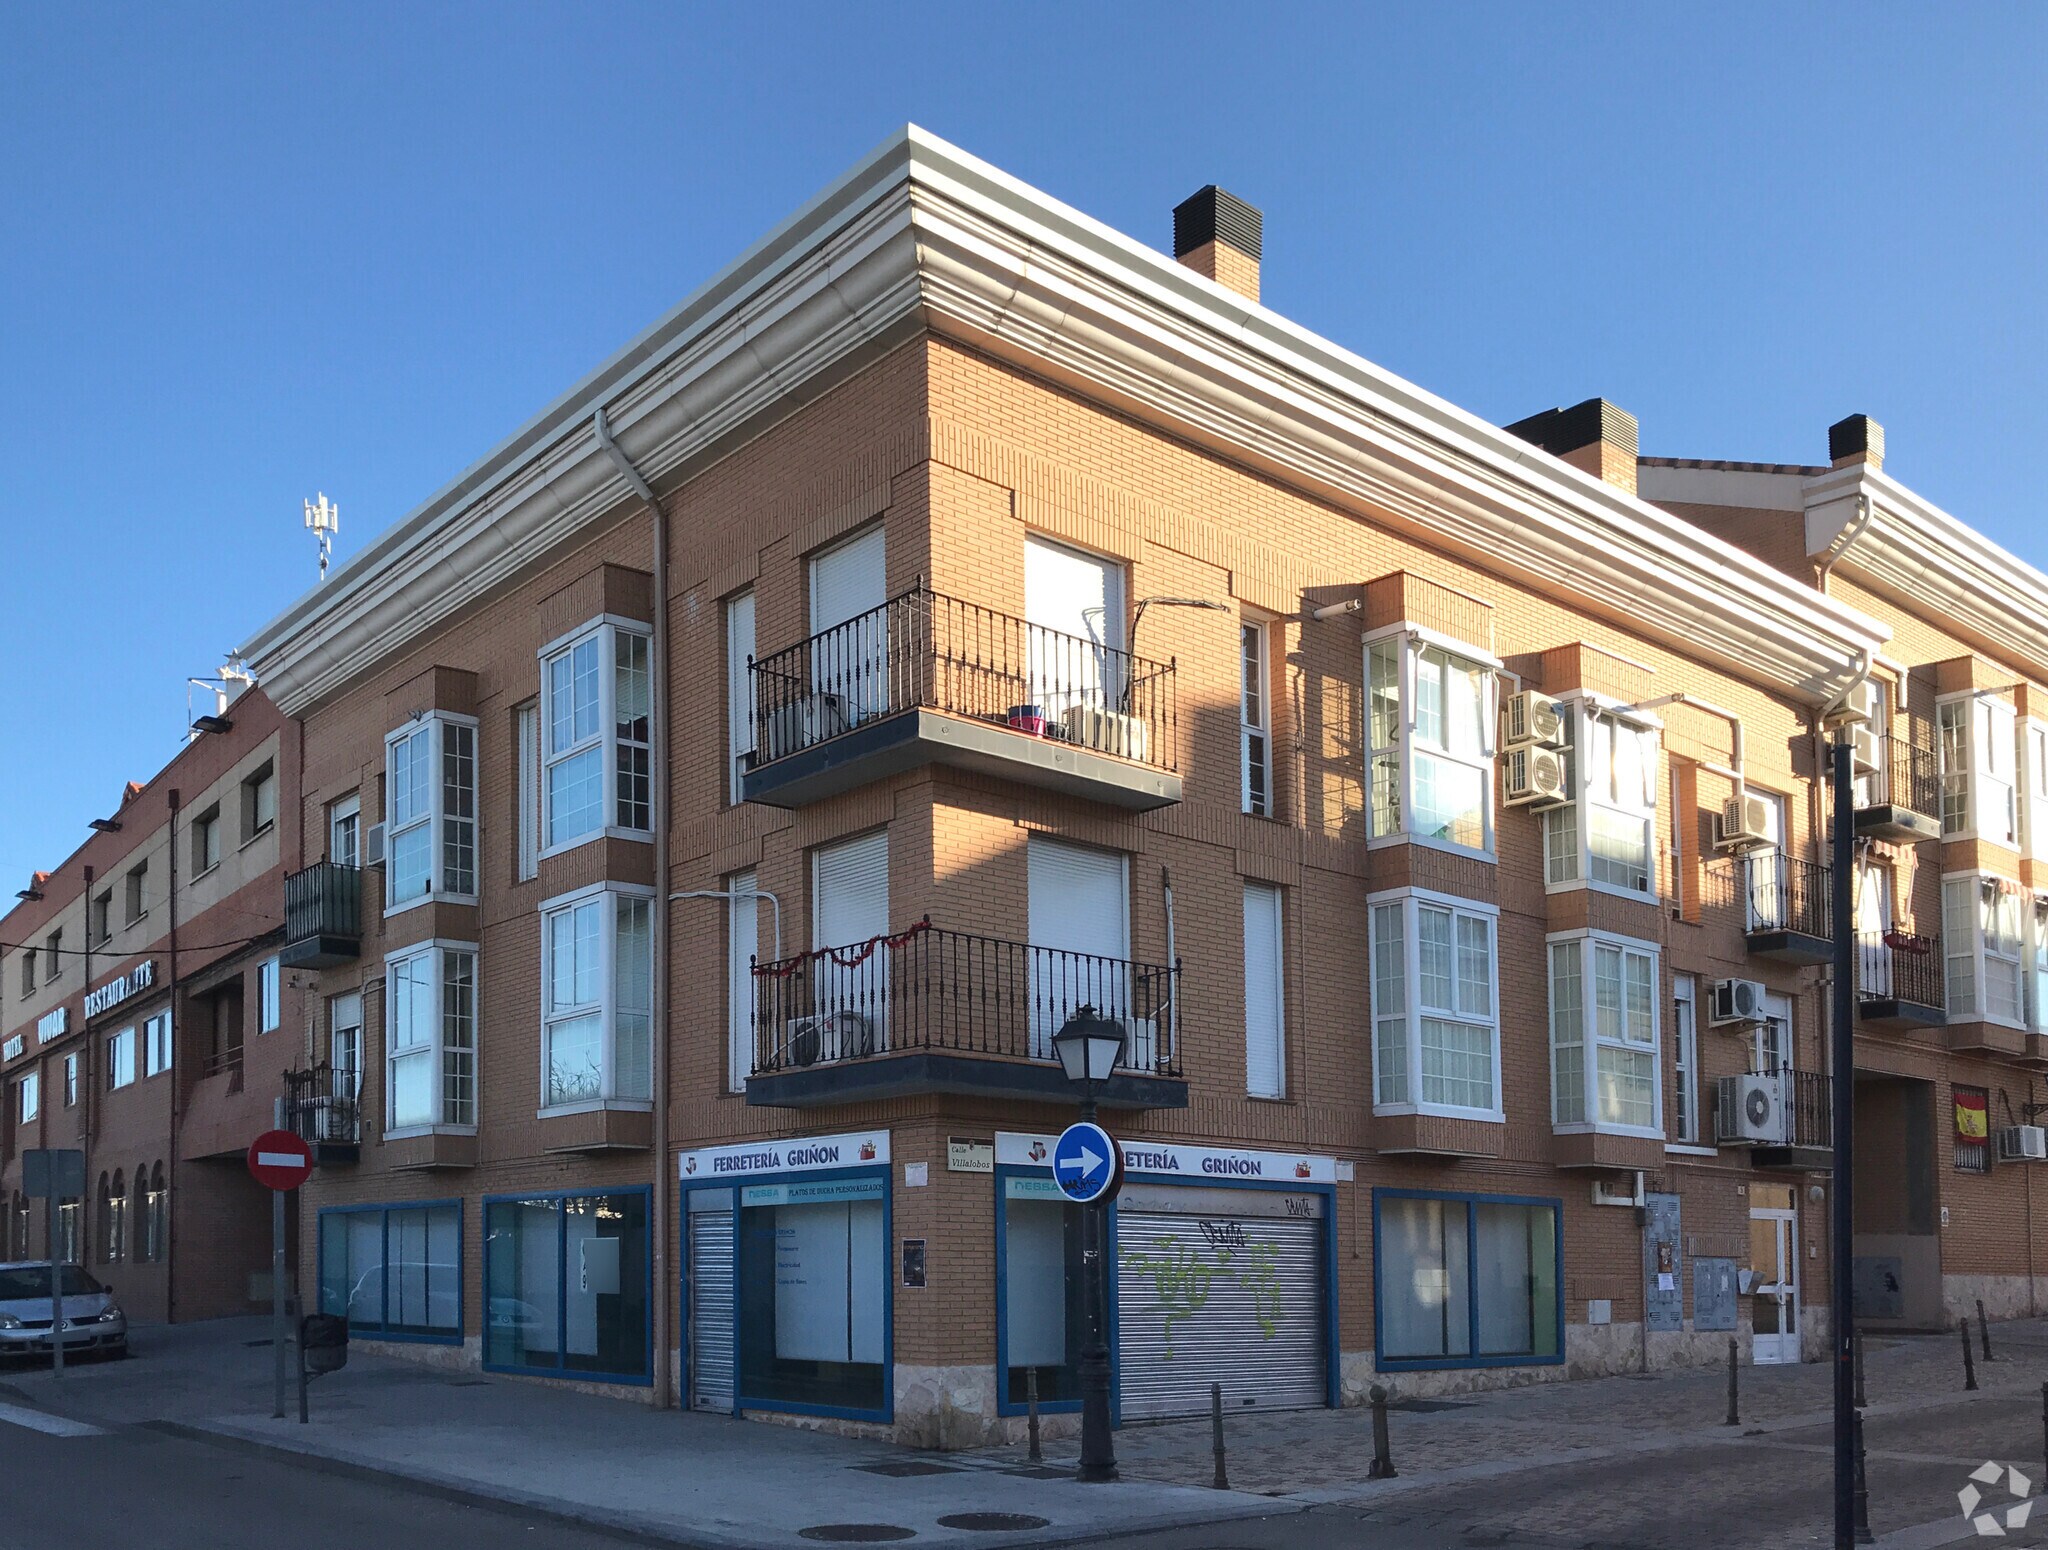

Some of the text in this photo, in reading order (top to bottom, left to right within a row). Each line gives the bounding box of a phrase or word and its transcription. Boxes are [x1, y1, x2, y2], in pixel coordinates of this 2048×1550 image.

[951, 1145, 967, 1154] Calle
[713, 1144, 839, 1172] FERRETERÍA GRIÑON
[951, 1158, 991, 1169] Villalobos
[1125, 1148, 1262, 1176] ETERÍA GRIÑON
[788, 1188, 809, 1197] PLATOS
[809, 1187, 816, 1196] DE
[817, 1186, 835, 1195] DUCHA
[835, 1184, 884, 1194] PERSONALIZADOS
